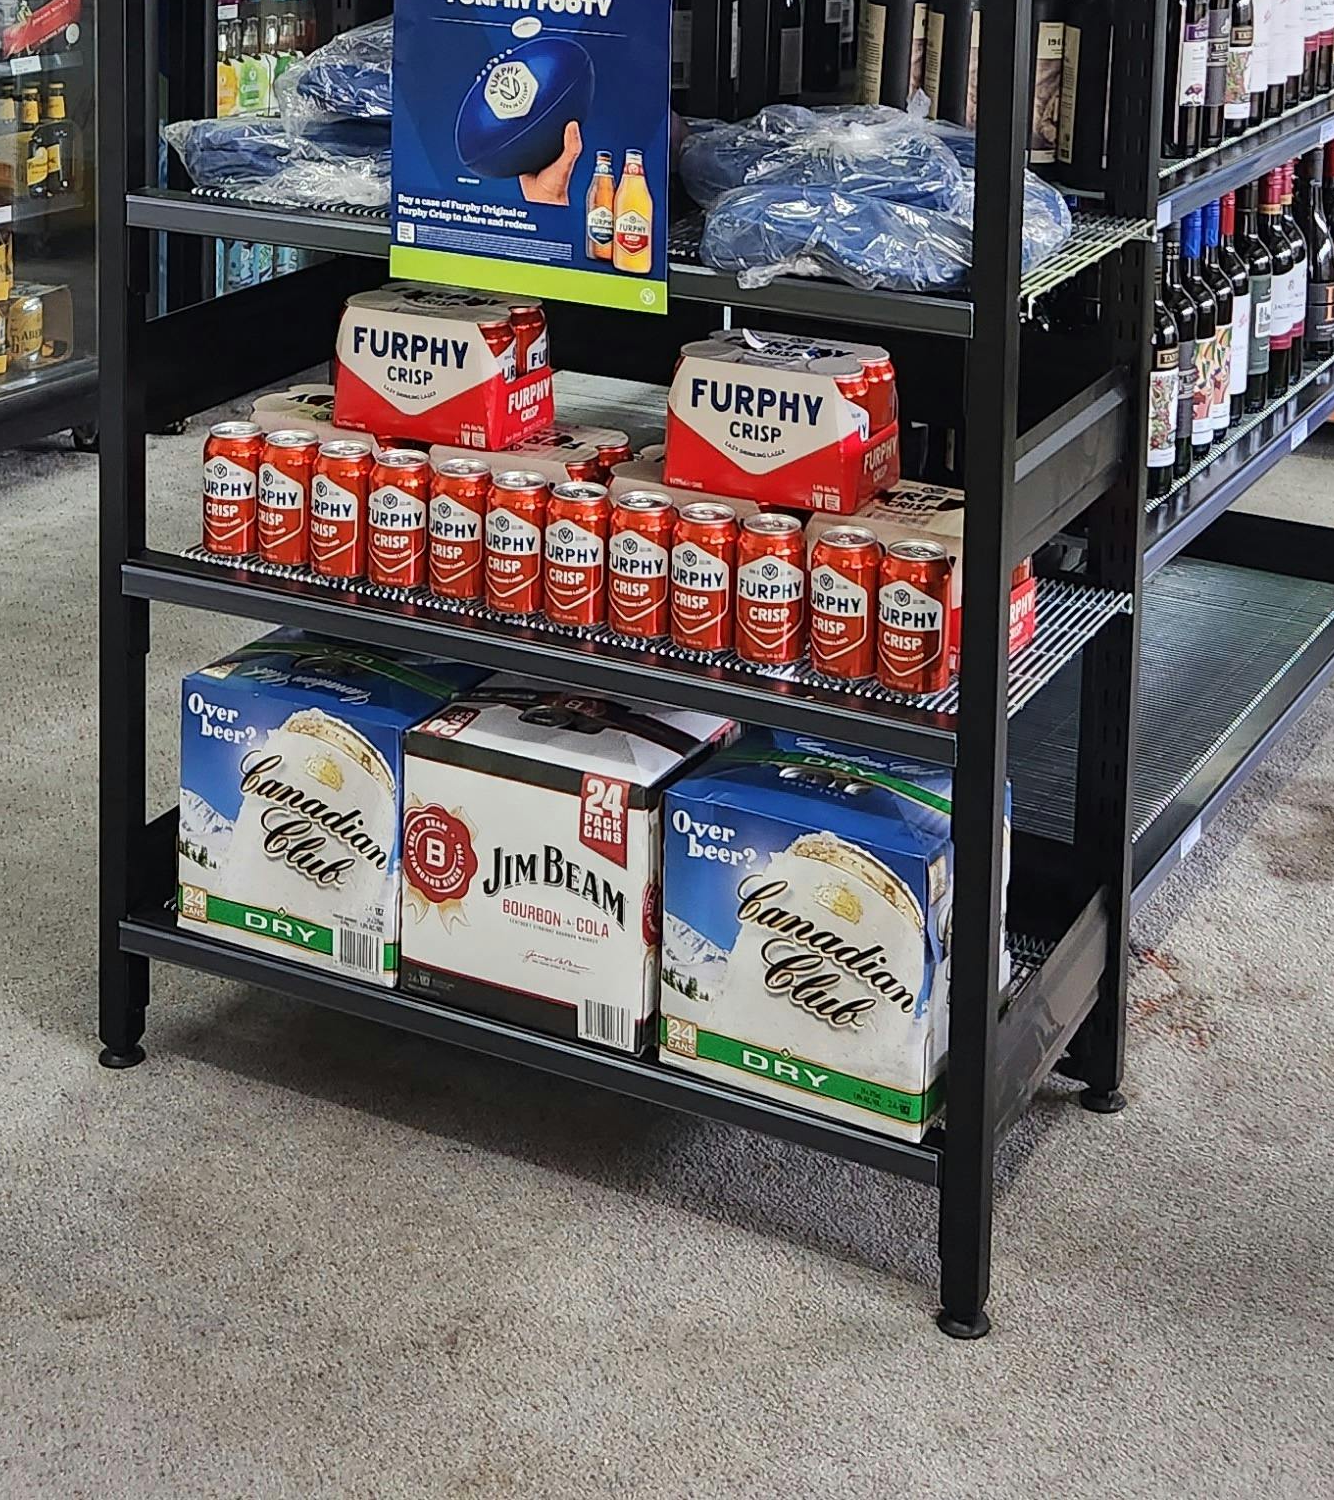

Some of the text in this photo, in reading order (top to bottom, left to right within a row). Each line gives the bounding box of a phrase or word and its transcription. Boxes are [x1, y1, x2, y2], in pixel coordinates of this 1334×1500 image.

[488, 65, 522, 95] FURPHY
[397, 194, 414, 205] Buy
[421, 199, 440, 207] case
[441, 199, 450, 208] of
[450, 200, 481, 214] Furphy
[482, 205, 516, 218] Original
[517, 210, 528, 218] or
[397, 205, 537, 231] Furphy Crisp to share and redeem
[618, 223, 646, 233] FURPHY
[353, 325, 469, 370] FURPHY
[387, 366, 433, 386] CRISP
[508, 378, 551, 412] FURPHY
[692, 378, 824, 426] FURPHY
[729, 422, 782, 443] CRISP
[863, 438, 900, 475] FURPHY
[203, 476, 252, 497] URPHY
[206, 503, 239, 517] CRISP
[373, 533, 409, 548] CRISP
[429, 520, 478, 539] URPHY
[431, 542, 463, 559] CRISP
[488, 555, 522, 572] CRISP
[549, 568, 585, 585] CRISP
[613, 579, 649, 596] CRISP
[739, 578, 801, 598] FURPHY
[187, 692, 238, 723] Over
[201, 714, 257, 746] beer?
[803, 755, 876, 778] DRY
[240, 750, 388, 870] Canadian
[585, 779, 624, 819] 24
[425, 819, 448, 832] BEAM
[584, 814, 622, 831] PACK
[672, 809, 736, 843] Over
[261, 807, 355, 887] Club
[584, 826, 623, 845] CANS
[425, 837, 445, 867] B
[688, 833, 756, 870] beer?
[183, 886, 205, 905] 24
[483, 845, 627, 932] JIM BEAM
[245, 912, 317, 942] DRY
[503, 899, 610, 938] BOURBON COLA
[736, 873, 914, 1013] Canadian
[760, 937, 876, 1028] Club
[669, 1018, 695, 1042] 24
[667, 1039, 696, 1055] CANS
[742, 1051, 829, 1088] DRY
